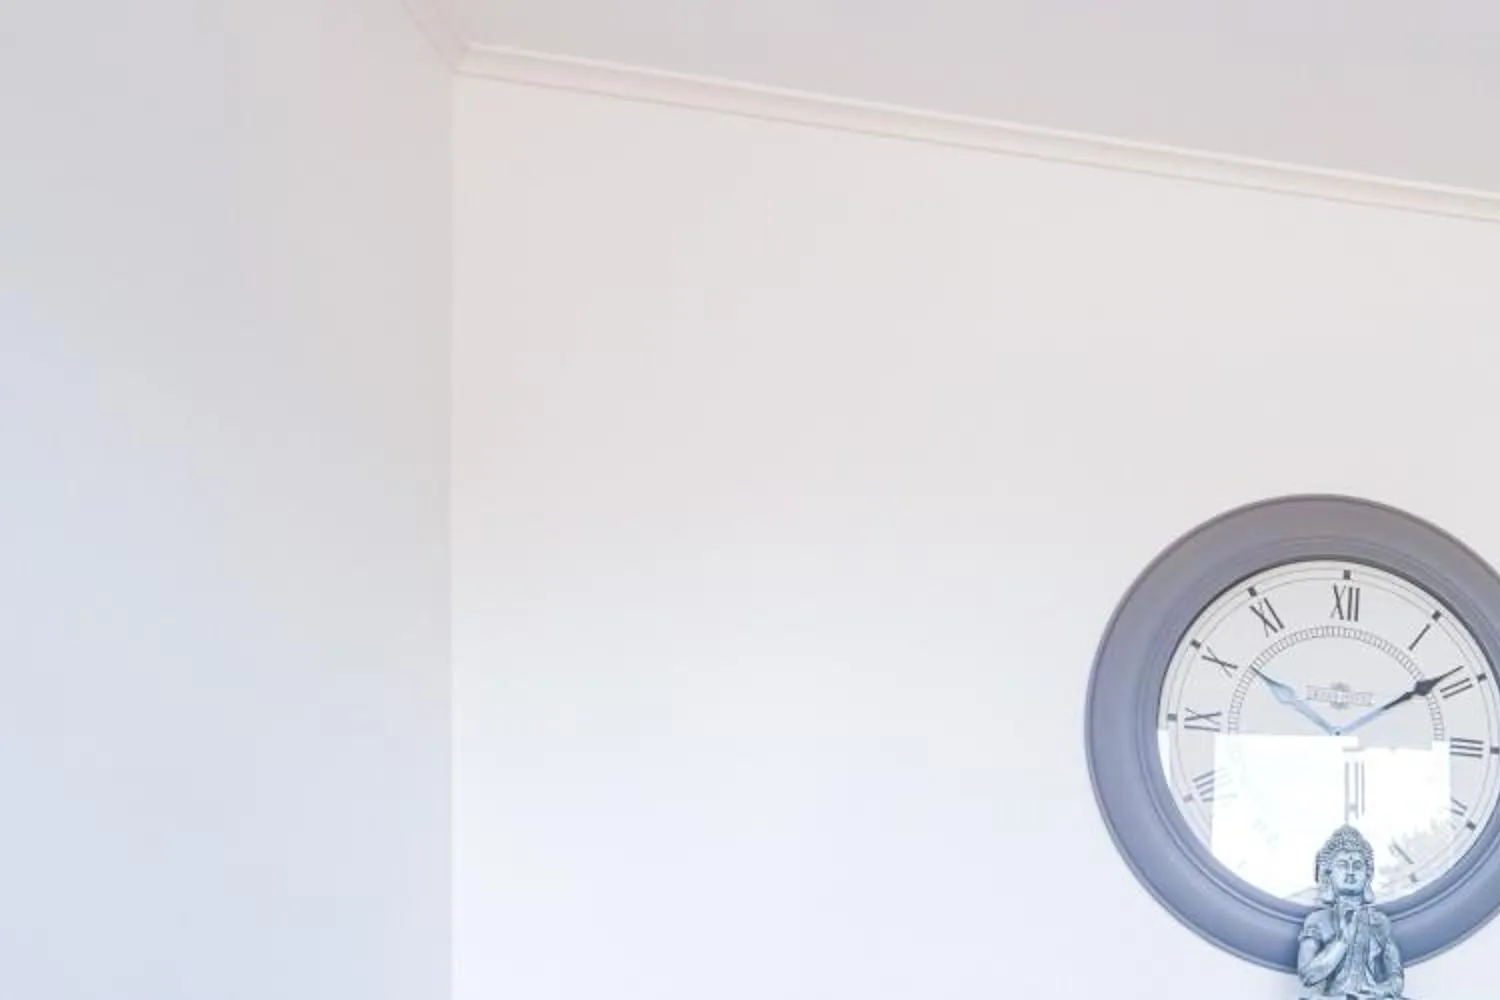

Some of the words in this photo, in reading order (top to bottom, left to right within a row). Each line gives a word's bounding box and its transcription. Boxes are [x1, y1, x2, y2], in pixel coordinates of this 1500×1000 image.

[1330, 584, 1361, 621] XII
[1248, 596, 1285, 639] XI
[1201, 646, 1239, 675] X
[1183, 707, 1222, 733] IX
[1449, 736, 1484, 759] III
